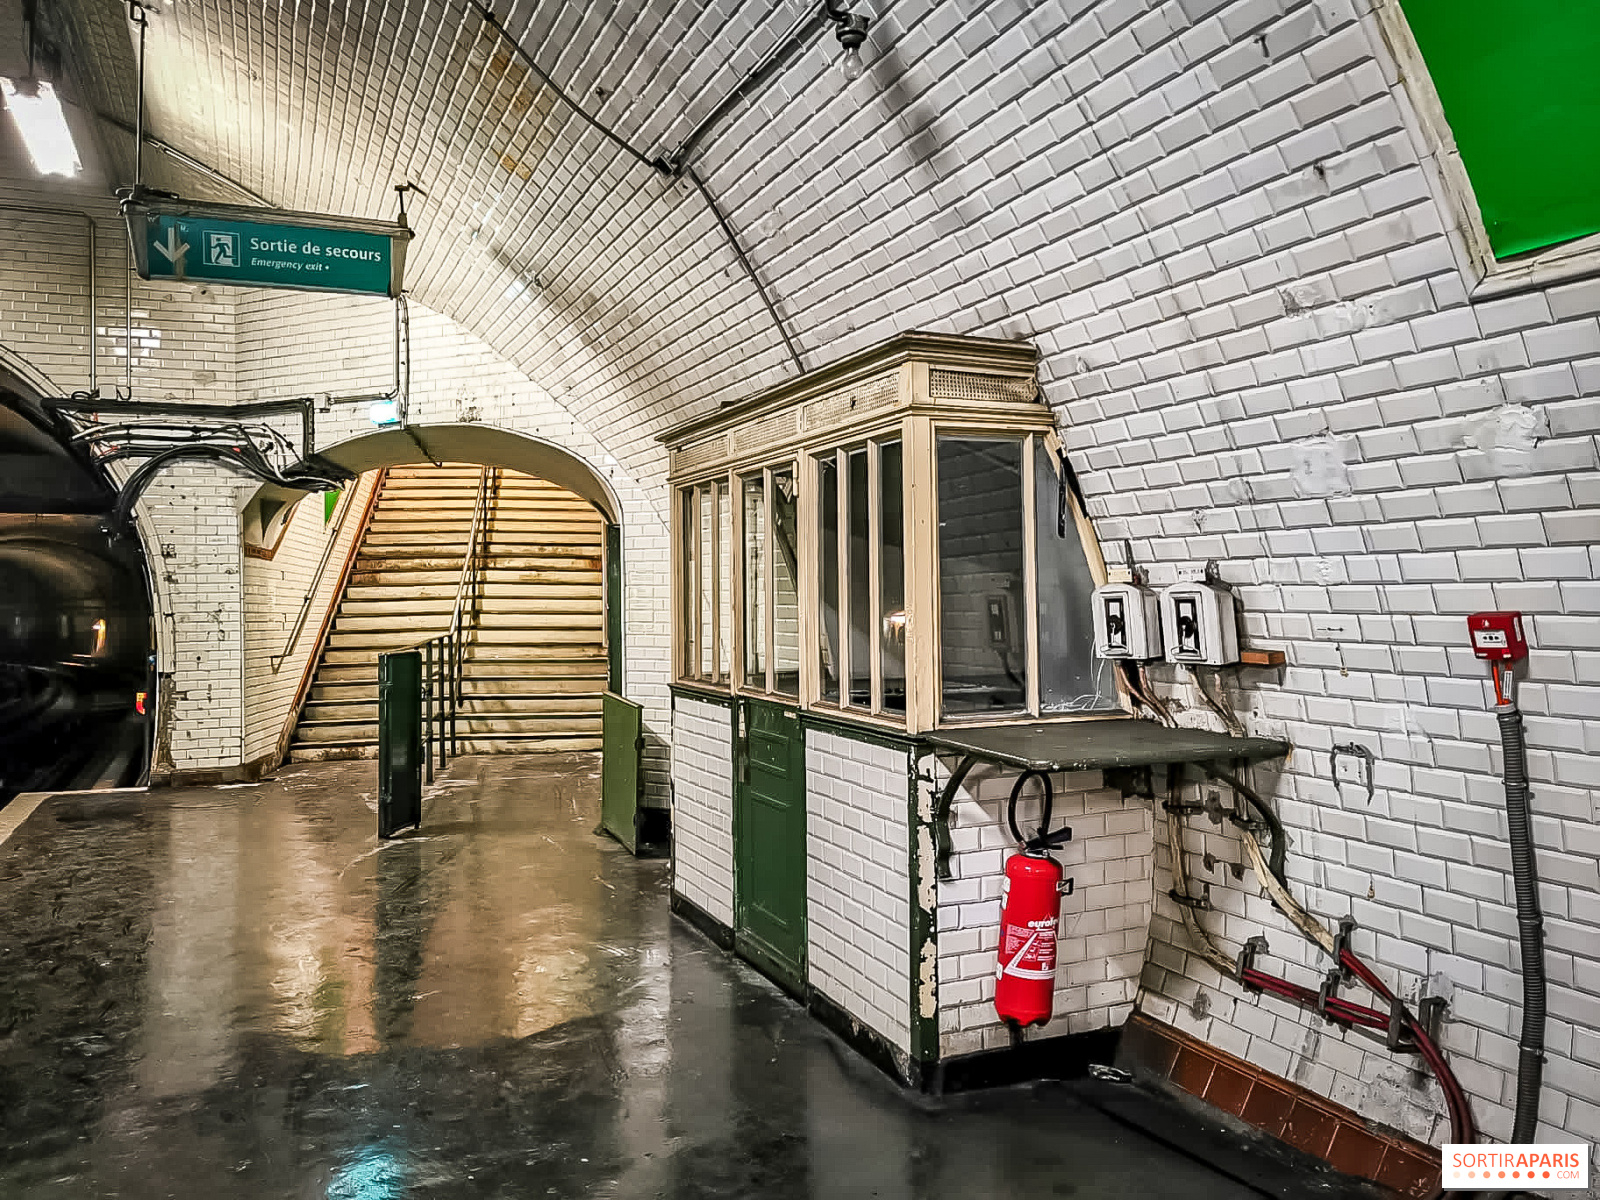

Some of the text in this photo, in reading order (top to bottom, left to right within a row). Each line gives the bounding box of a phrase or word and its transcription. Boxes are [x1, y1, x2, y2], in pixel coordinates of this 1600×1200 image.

[250, 237, 382, 262] Sortie de secours
[251, 257, 322, 271] Emergency exit
